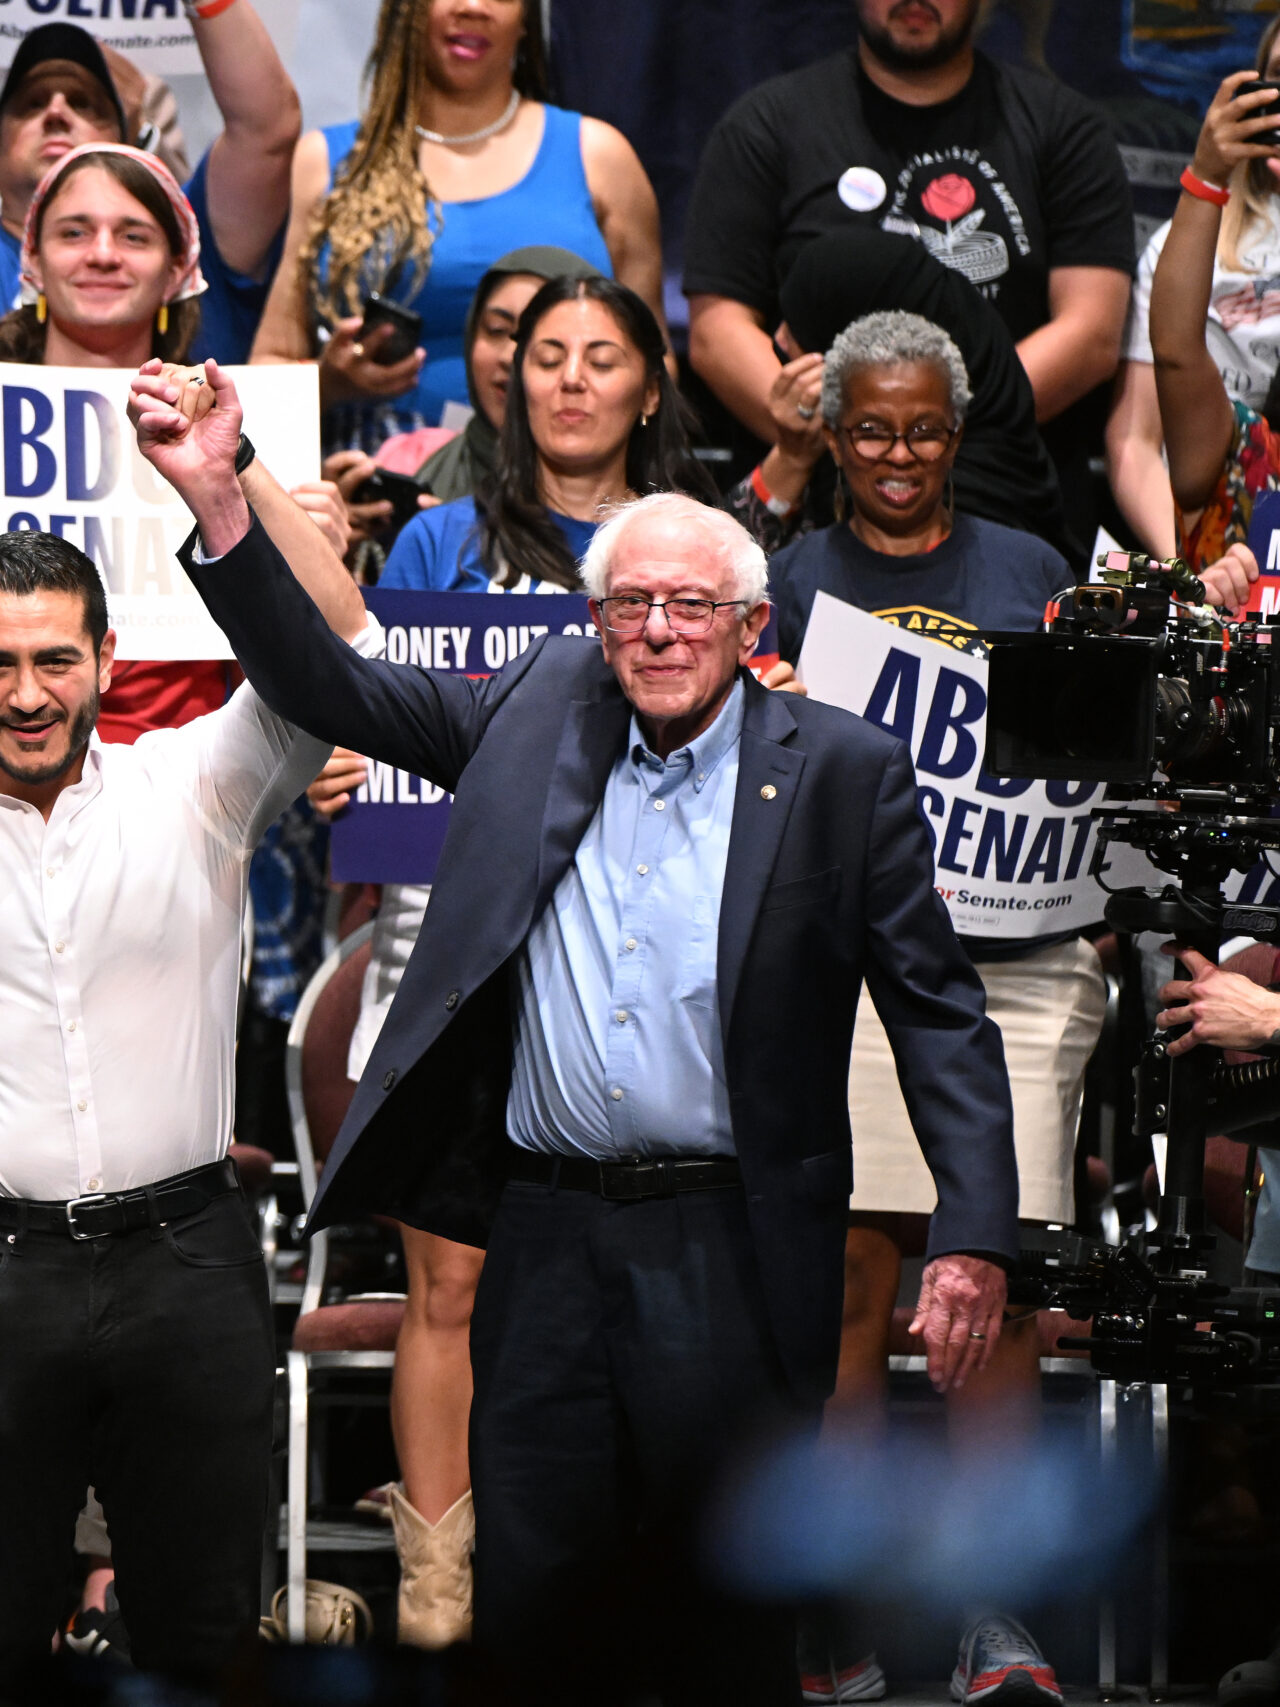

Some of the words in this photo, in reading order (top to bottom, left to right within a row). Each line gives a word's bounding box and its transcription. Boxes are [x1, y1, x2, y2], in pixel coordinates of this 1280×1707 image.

[380, 625, 471, 670] ONEY
[356, 757, 455, 804] ME
[934, 885, 1073, 911] orSenate.com
